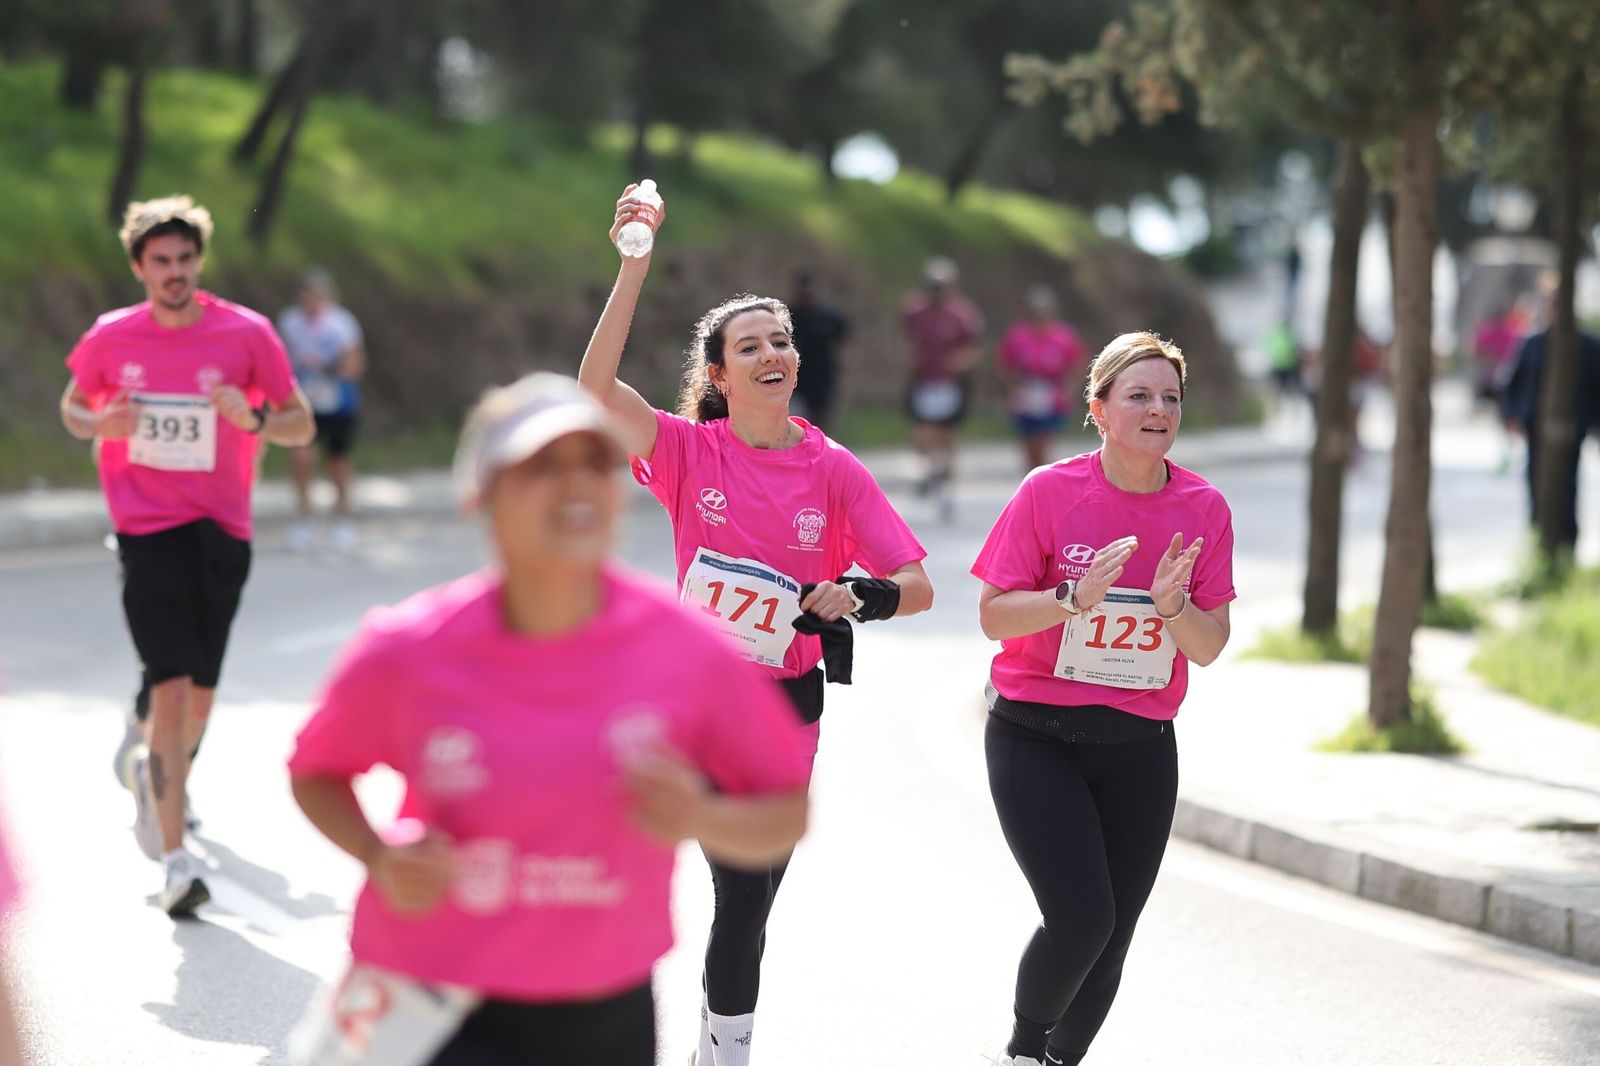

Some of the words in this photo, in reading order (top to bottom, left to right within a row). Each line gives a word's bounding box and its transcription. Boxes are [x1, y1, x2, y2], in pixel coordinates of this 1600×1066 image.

[141, 412, 200, 443] 393
[696, 502, 727, 525] HYUNDAI
[1058, 562, 1089, 575] HYUND
[701, 580, 780, 635] 171
[1085, 615, 1164, 652] 123
